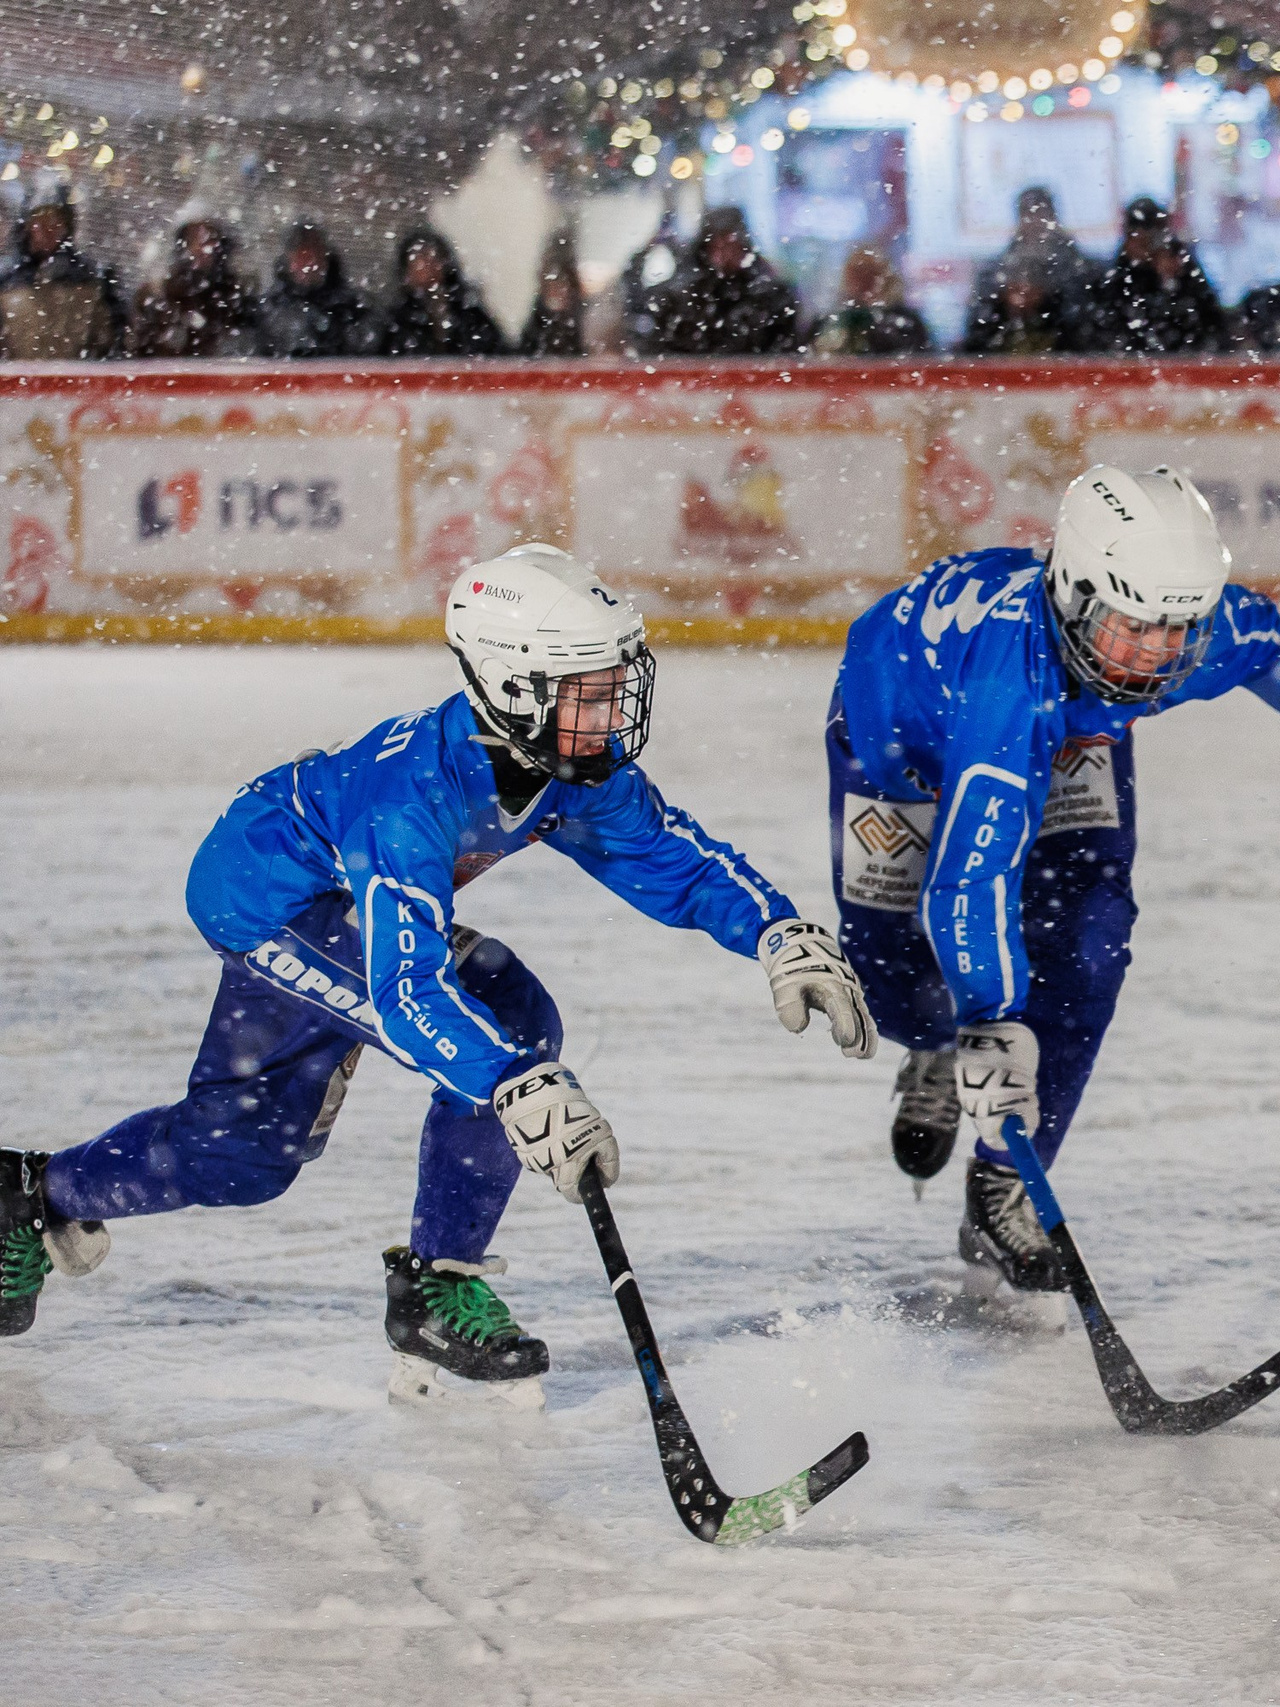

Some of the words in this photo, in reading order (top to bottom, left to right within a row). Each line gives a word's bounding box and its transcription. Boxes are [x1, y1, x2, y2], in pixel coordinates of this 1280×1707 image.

[218, 477, 343, 529] ПСБ
[1092, 481, 1135, 522] CCM
[483, 584, 525, 604] BANDY
[590, 587, 618, 607] 2
[1161, 595, 1203, 604] CCM
[477, 636, 516, 651] BAUER
[249, 939, 375, 1025] КОРОЛ
[396, 900, 459, 1062] КОРОЛЁВ
[958, 1033, 1015, 1054] TEX
[496, 1070, 560, 1120] STEX
